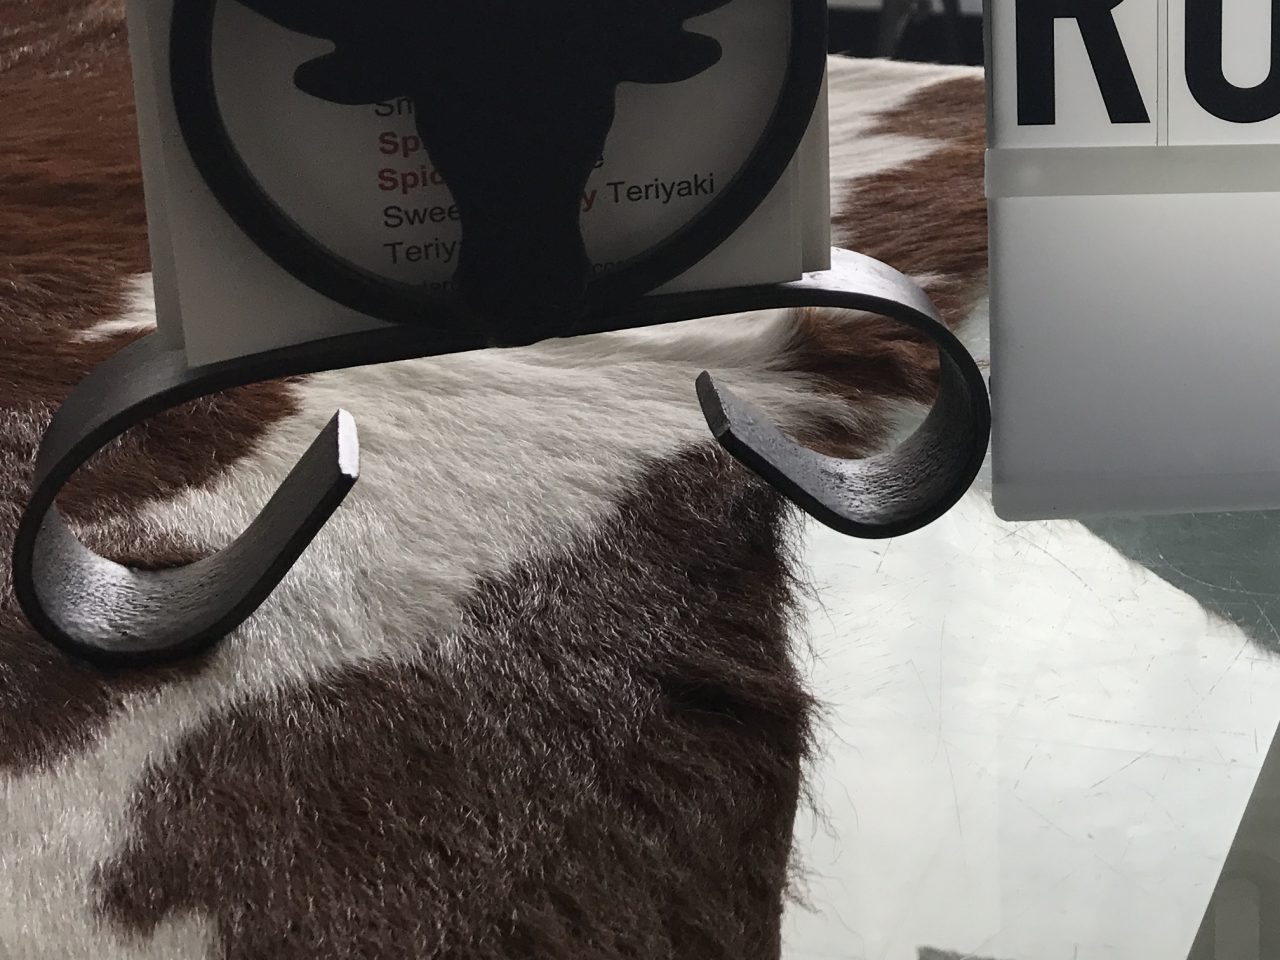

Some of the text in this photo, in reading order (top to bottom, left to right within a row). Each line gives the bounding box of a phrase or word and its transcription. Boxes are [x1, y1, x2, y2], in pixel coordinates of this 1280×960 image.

[378, 163, 445, 195] Spic
[383, 204, 462, 228] Swee
[606, 172, 715, 205] Teriyaki
